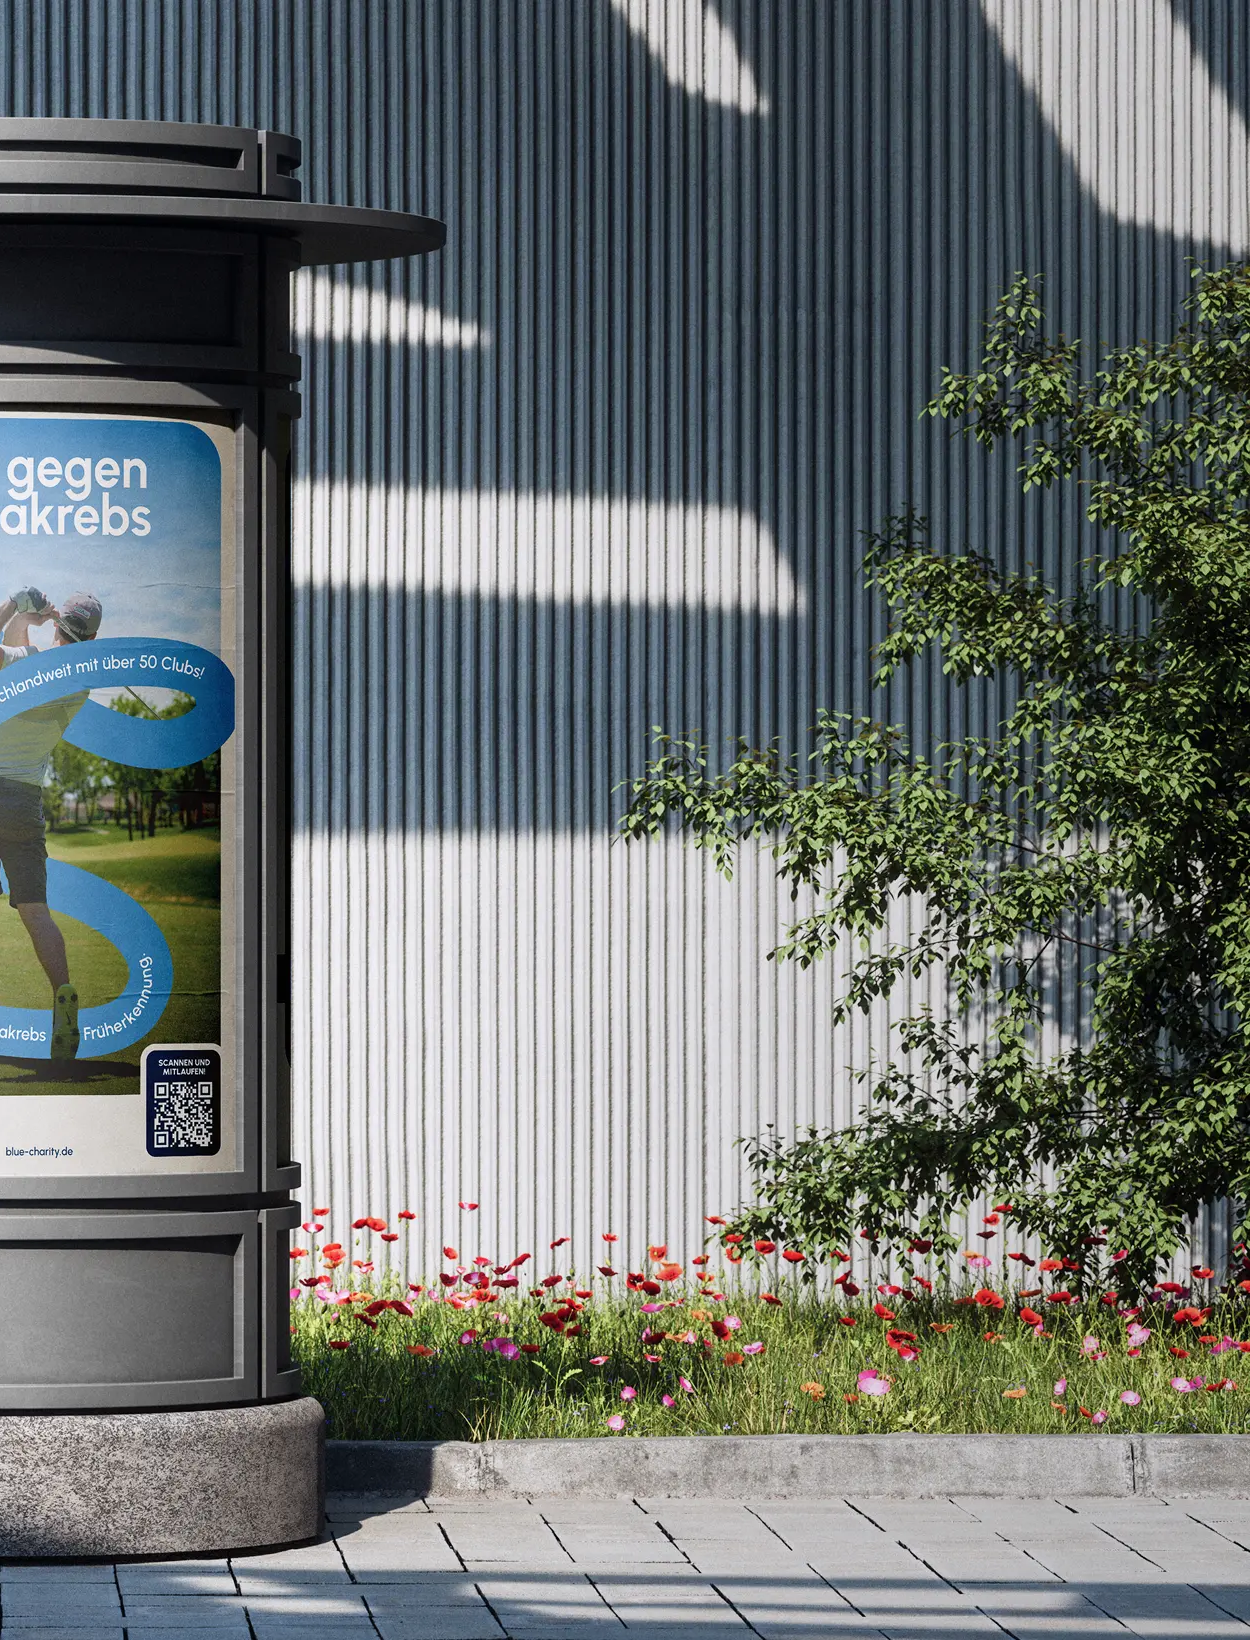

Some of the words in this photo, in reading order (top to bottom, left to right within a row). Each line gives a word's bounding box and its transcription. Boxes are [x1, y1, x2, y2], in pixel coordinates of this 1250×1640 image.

[7, 456, 147, 502] gegen
[75, 657, 99, 674] mit
[102, 655, 136, 670] über
[139, 655, 158, 669] 50
[161, 656, 206, 680] Clubs!
[83, 953, 153, 1041] Früherkennung.
[158, 1059, 193, 1067] SCANNEN
[162, 1068, 206, 1076] MITLAUFEN!
[5, 1146, 74, 1158] blue-charity.de
